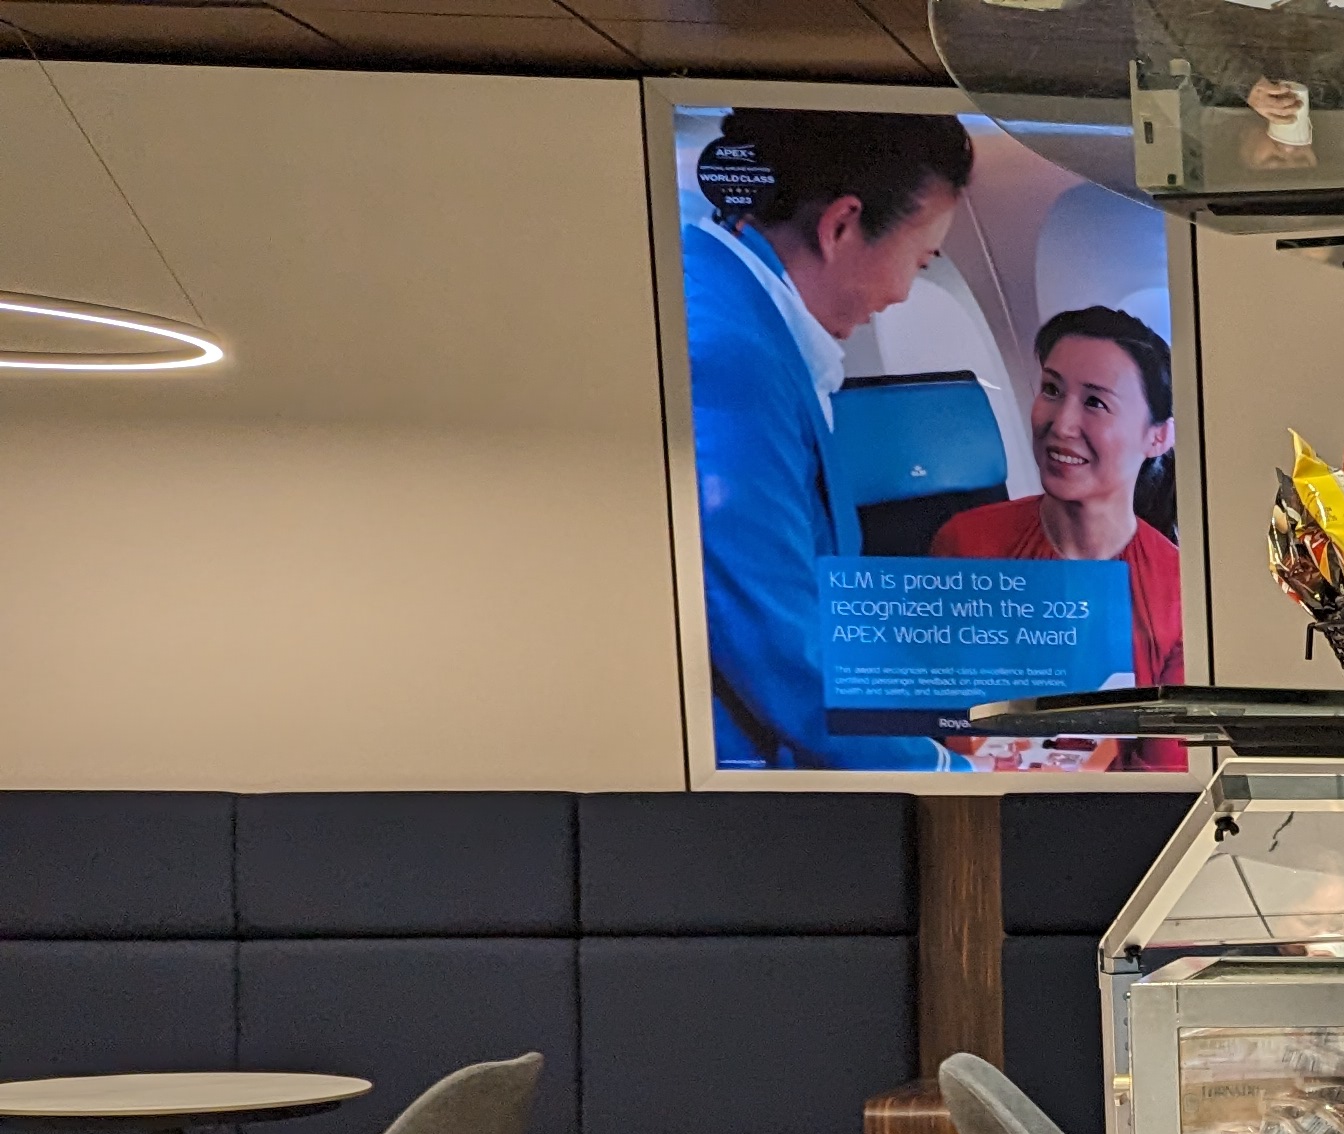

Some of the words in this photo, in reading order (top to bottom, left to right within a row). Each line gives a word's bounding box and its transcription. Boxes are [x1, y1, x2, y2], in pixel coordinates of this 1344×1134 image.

[700, 174, 739, 183] WORLD
[740, 174, 775, 184] CLASS
[829, 571, 874, 589] KLM
[880, 570, 896, 589] is
[903, 572, 963, 593] proud
[971, 573, 993, 591] to
[1000, 572, 1027, 591] be
[831, 598, 943, 621] recognized
[951, 599, 993, 618] with
[1000, 599, 1035, 618] the
[1042, 600, 1090, 619] 2023
[832, 625, 887, 643] APEX
[893, 625, 951, 645] World
[959, 626, 1009, 645] Class
[1016, 627, 1077, 645] Award
